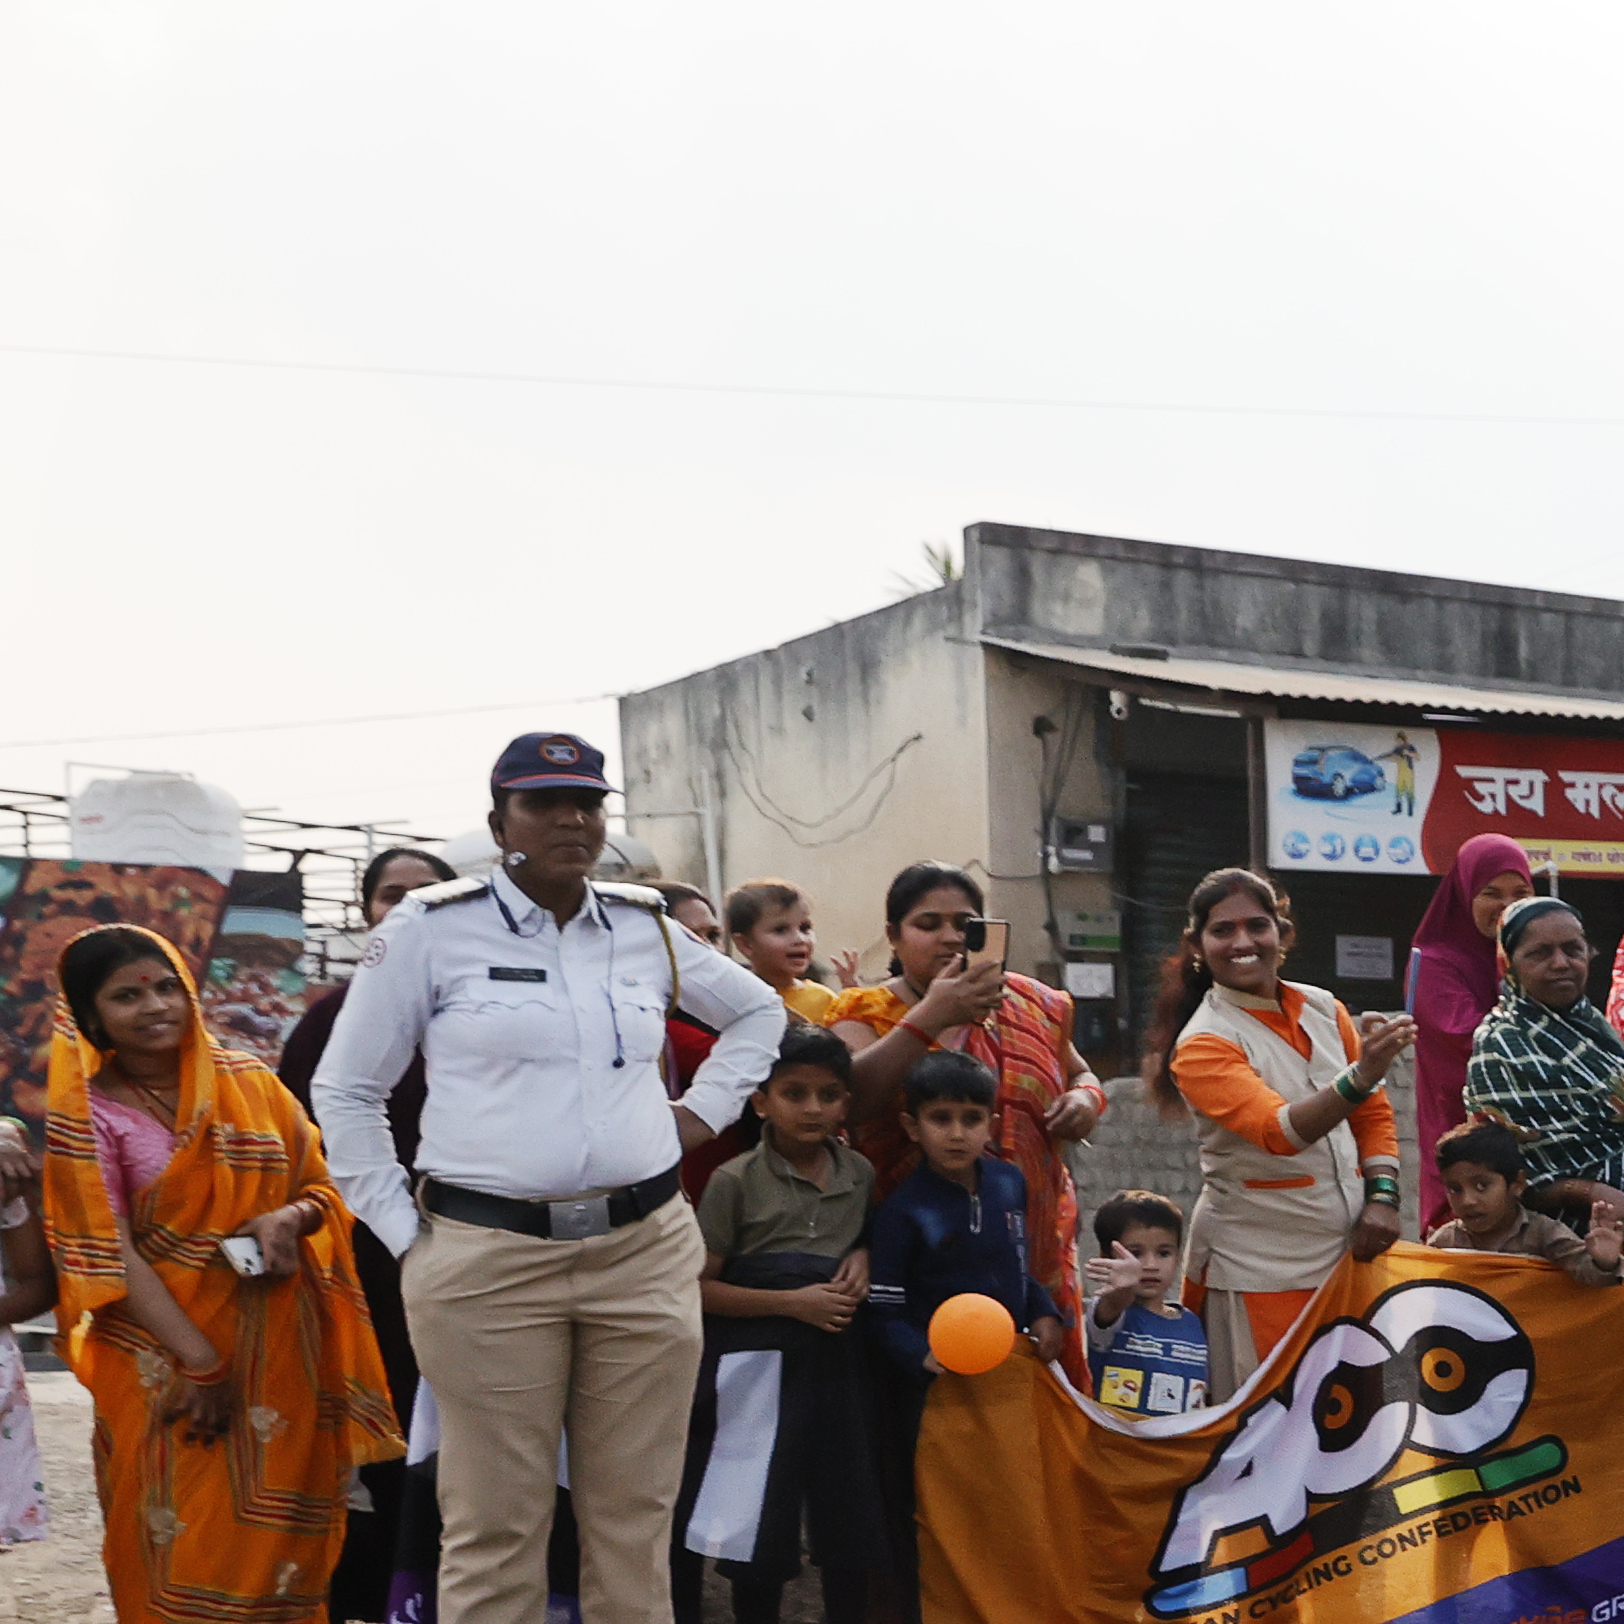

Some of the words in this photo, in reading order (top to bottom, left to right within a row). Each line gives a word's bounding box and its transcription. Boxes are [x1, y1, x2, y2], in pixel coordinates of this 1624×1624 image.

[1453, 764, 1551, 818] जय
[1249, 1555, 1353, 1620] CYCLING
[1360, 1475, 1582, 1566] CONFEDERATION
